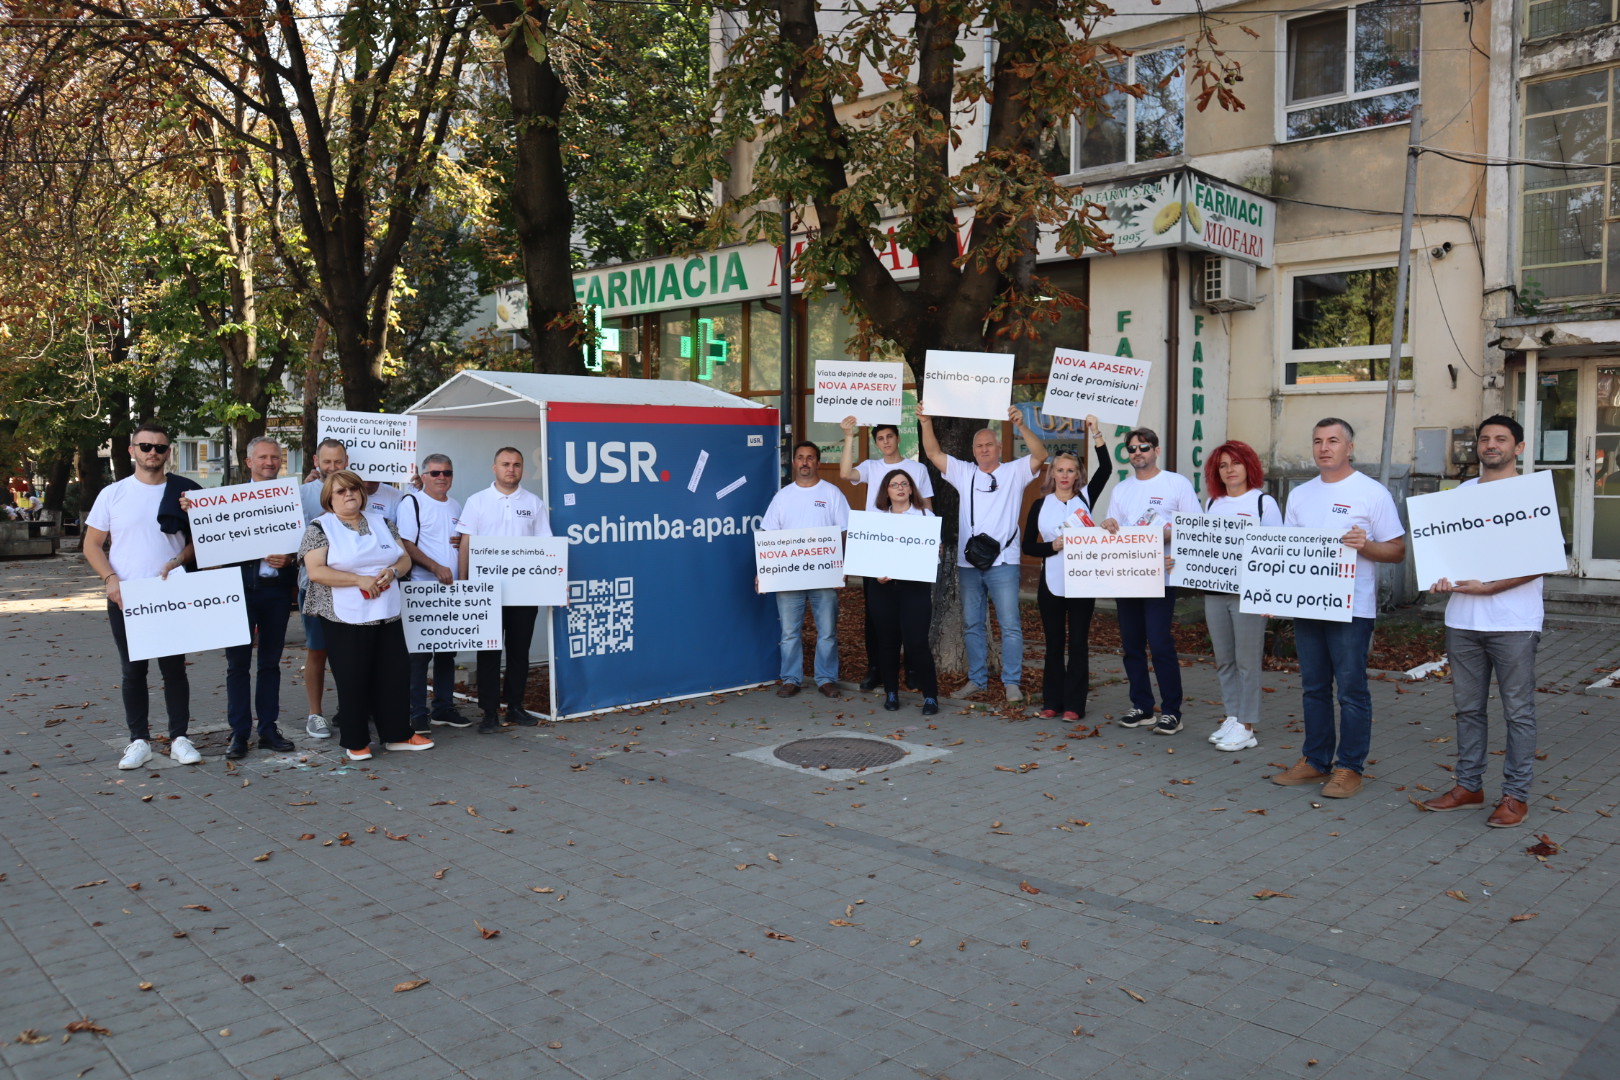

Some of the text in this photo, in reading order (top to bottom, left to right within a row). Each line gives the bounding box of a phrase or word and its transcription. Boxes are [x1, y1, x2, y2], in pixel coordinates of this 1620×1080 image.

[1095, 188, 1131, 202] FARM
[1195, 183, 1263, 227] FARMACI
[1117, 233, 1141, 245] 1995
[573, 251, 748, 310] FARMACIA
[1055, 356, 1144, 377] NOVA APASERV:
[838, 370, 867, 378] depinde
[926, 370, 1010, 384] schimba-apa.ro
[1052, 372, 1069, 380] ani
[1071, 373, 1084, 383] de
[818, 381, 897, 391] NOVA APASERV
[816, 395, 901, 406] depinde de noi!!!
[1050, 387, 1139, 407] doar țevi stricate!
[320, 415, 358, 424] Conducte
[359, 418, 407, 427] cancerigene
[325, 425, 356, 434] Avarii
[358, 427, 371, 435] cu
[373, 427, 401, 437] lunile
[360, 440, 376, 449] cu
[379, 439, 416, 452] anii!!!
[349, 462, 365, 471] cu
[368, 462, 407, 475] porția
[565, 441, 671, 484] USR.
[189, 486, 294, 509] NOVA APASERV:
[193, 513, 213, 526] ani
[215, 512, 230, 522] de
[1175, 515, 1210, 529] Gropile
[1212, 517, 1221, 531] și
[1413, 505, 1551, 539] schimba-apa.ro
[197, 520, 301, 544] doar țevi stricate!
[567, 514, 763, 545] schimba-apa.ro
[777, 538, 806, 546] depinde
[847, 531, 936, 546] schimba-apa.ro
[1065, 534, 1158, 545] NOVA APASERV:
[1176, 529, 1244, 546] învechite sun
[1246, 533, 1287, 542] Conducte
[759, 546, 837, 559] NOVA APASERV
[1066, 551, 1083, 560] ani
[1085, 551, 1098, 560] de
[1177, 547, 1243, 561] semnele une
[1251, 545, 1284, 556] Avarii
[1286, 548, 1300, 557] cu
[1303, 546, 1337, 558] lunile
[476, 564, 564, 578] Țevile pe când?
[759, 560, 843, 575] depinde de noi!!!
[1068, 567, 1160, 580] doar țevi stricate!
[1186, 563, 1237, 576] conduceri
[1247, 560, 1355, 579] Gropi cu anii!!!
[404, 582, 494, 596] Gropile și țevile
[1183, 577, 1239, 592] nepotrivite
[124, 594, 240, 617] schimba-apa.ro
[406, 597, 492, 608] învechite sunt
[1243, 589, 1272, 605] Apă
[1275, 593, 1293, 604] cu
[1296, 593, 1343, 611] porția
[408, 610, 488, 623] semnele unei
[420, 624, 480, 636] conduceri
[417, 639, 483, 652] nepotrivite
